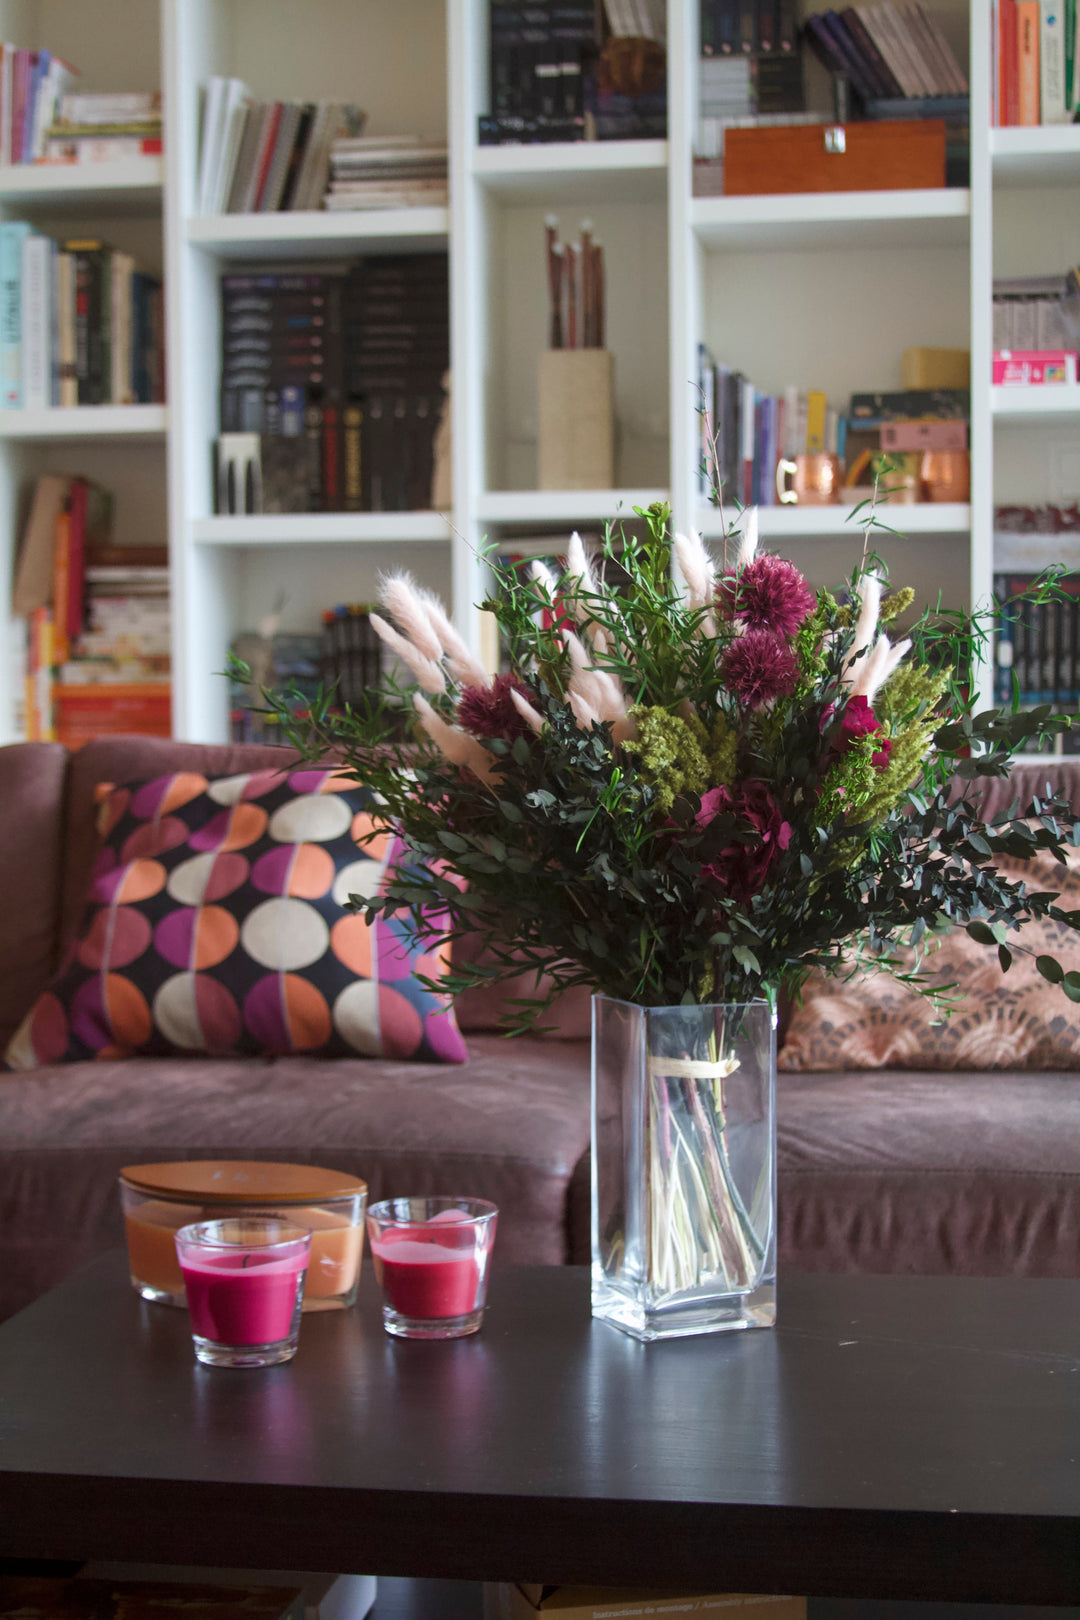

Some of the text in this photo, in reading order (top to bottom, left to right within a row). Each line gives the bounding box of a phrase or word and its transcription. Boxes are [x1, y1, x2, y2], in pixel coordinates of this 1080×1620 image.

[592, 1608, 643, 1619] Instructions
[644, 1606, 655, 1614] de
[656, 1604, 693, 1612] montage
